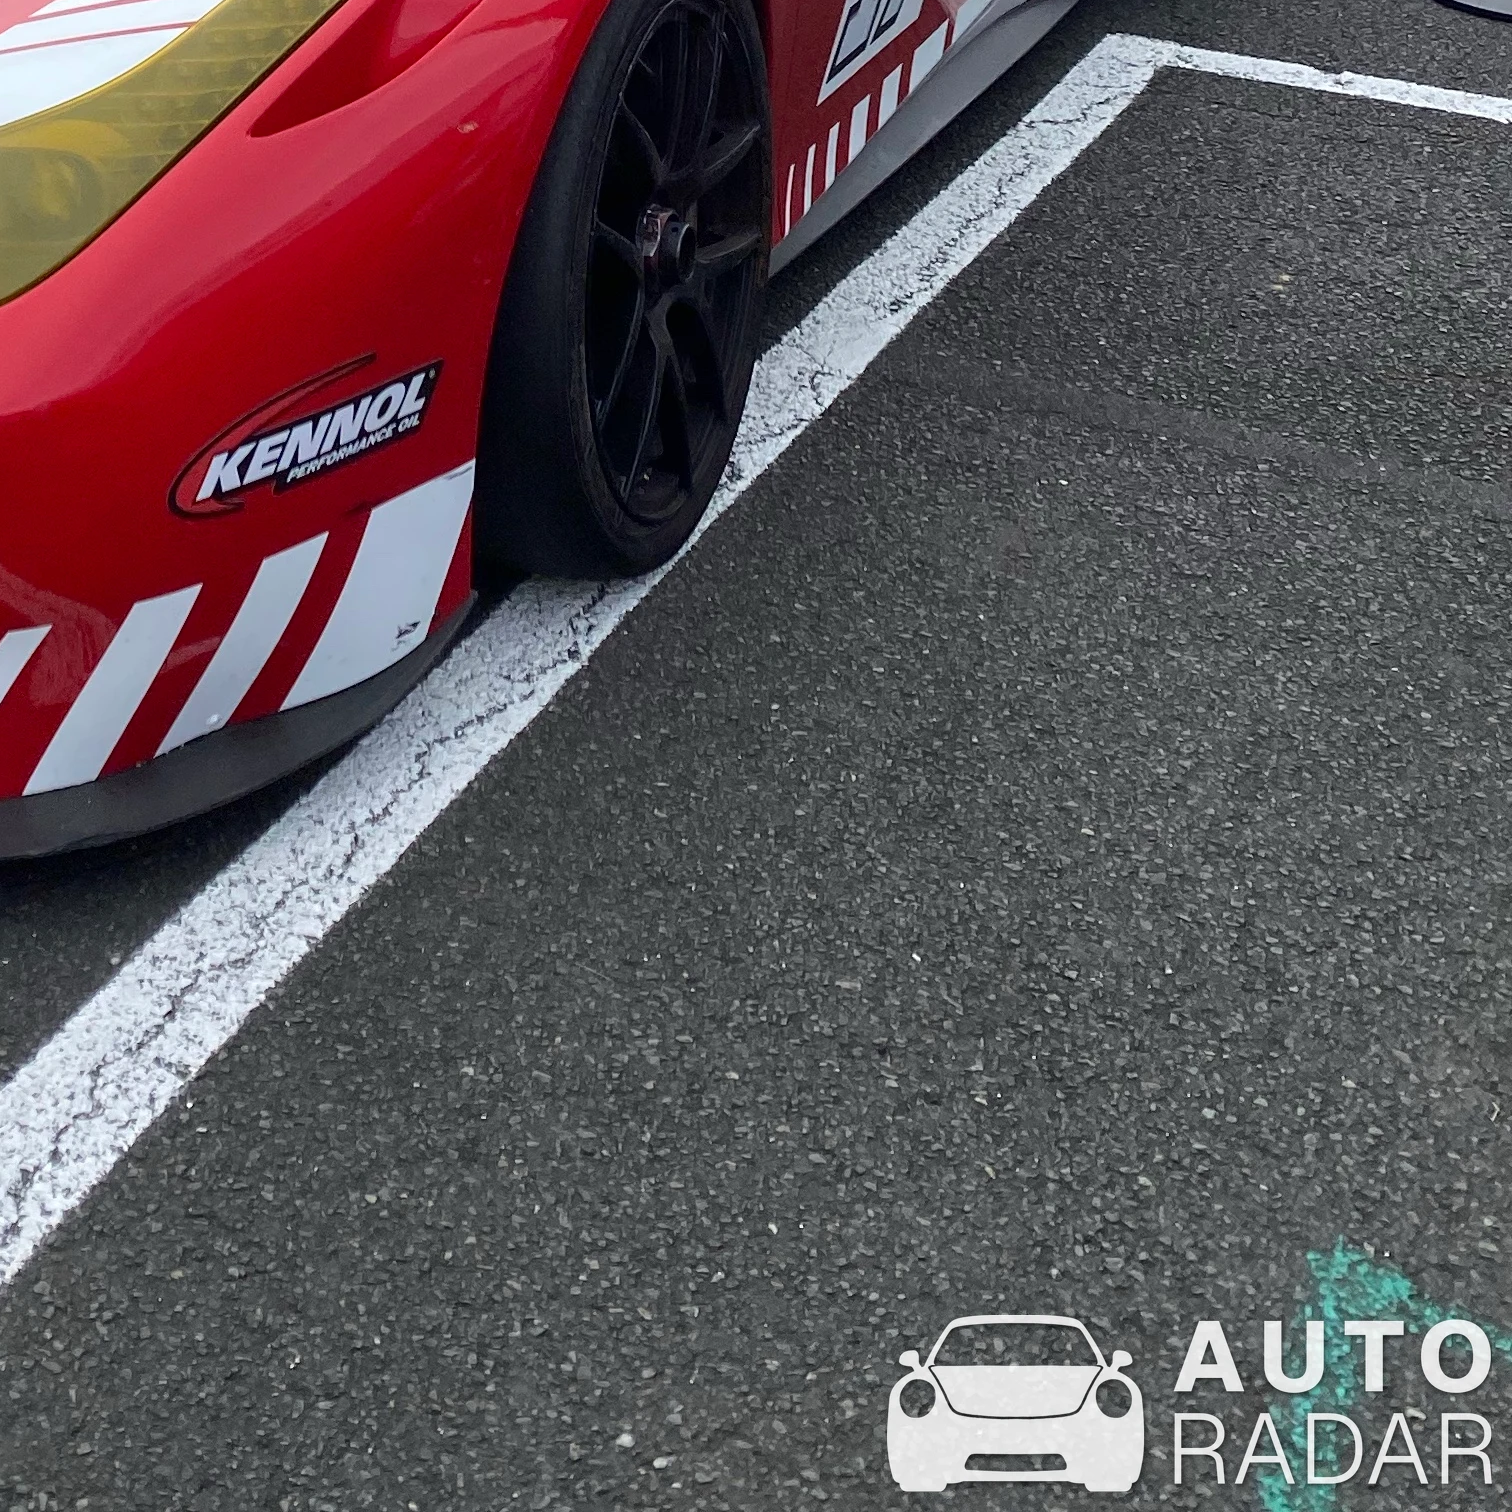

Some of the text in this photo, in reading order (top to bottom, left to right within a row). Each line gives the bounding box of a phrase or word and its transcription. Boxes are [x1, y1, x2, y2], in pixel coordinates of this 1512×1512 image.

[195, 372, 427, 503] KENNOL
[286, 412, 421, 483] PERFORMANCE OIL
